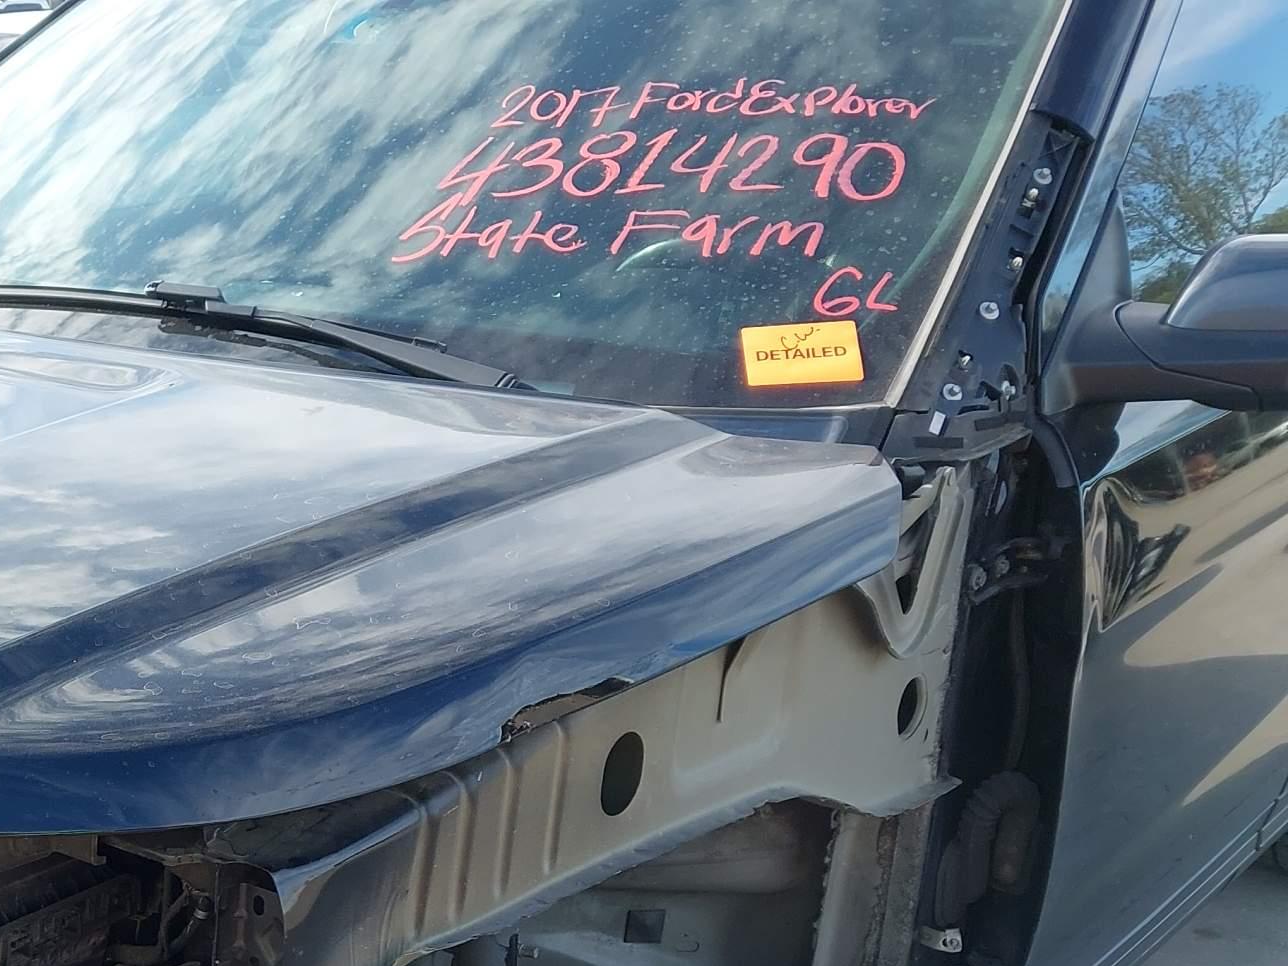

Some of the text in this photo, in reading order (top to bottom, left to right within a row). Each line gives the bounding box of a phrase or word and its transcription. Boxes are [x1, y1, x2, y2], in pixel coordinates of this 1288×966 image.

[490, 84, 631, 128] 2017
[437, 128, 906, 207] 43814290
[391, 191, 825, 263] State Farm
[755, 345, 848, 363] DETAILED
